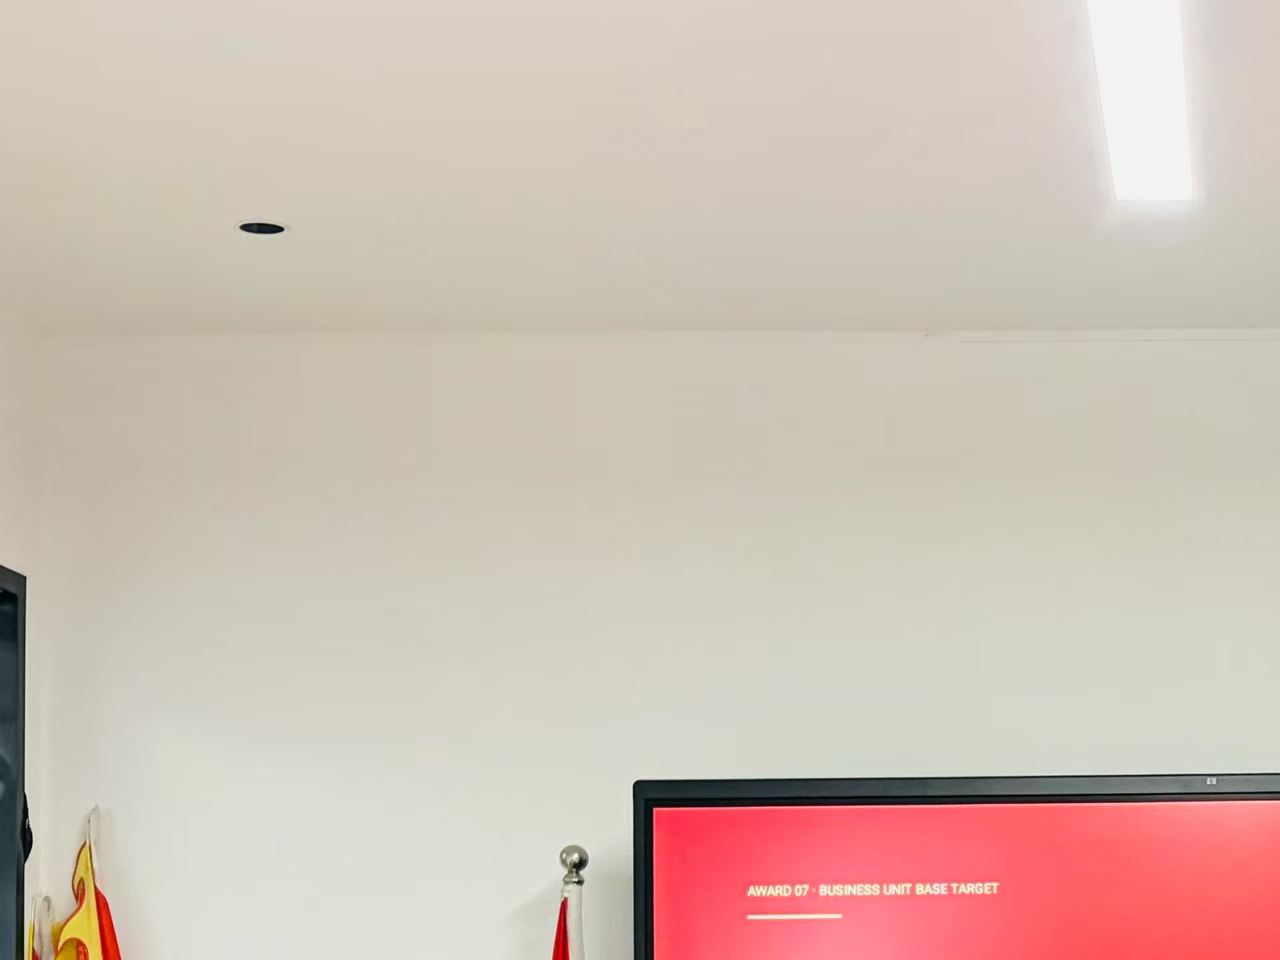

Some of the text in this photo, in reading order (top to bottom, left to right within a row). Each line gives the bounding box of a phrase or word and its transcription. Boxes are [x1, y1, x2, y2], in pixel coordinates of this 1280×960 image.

[747, 882, 999, 897] AWARD 07 BUSINESS UNIT BASE TARGET
